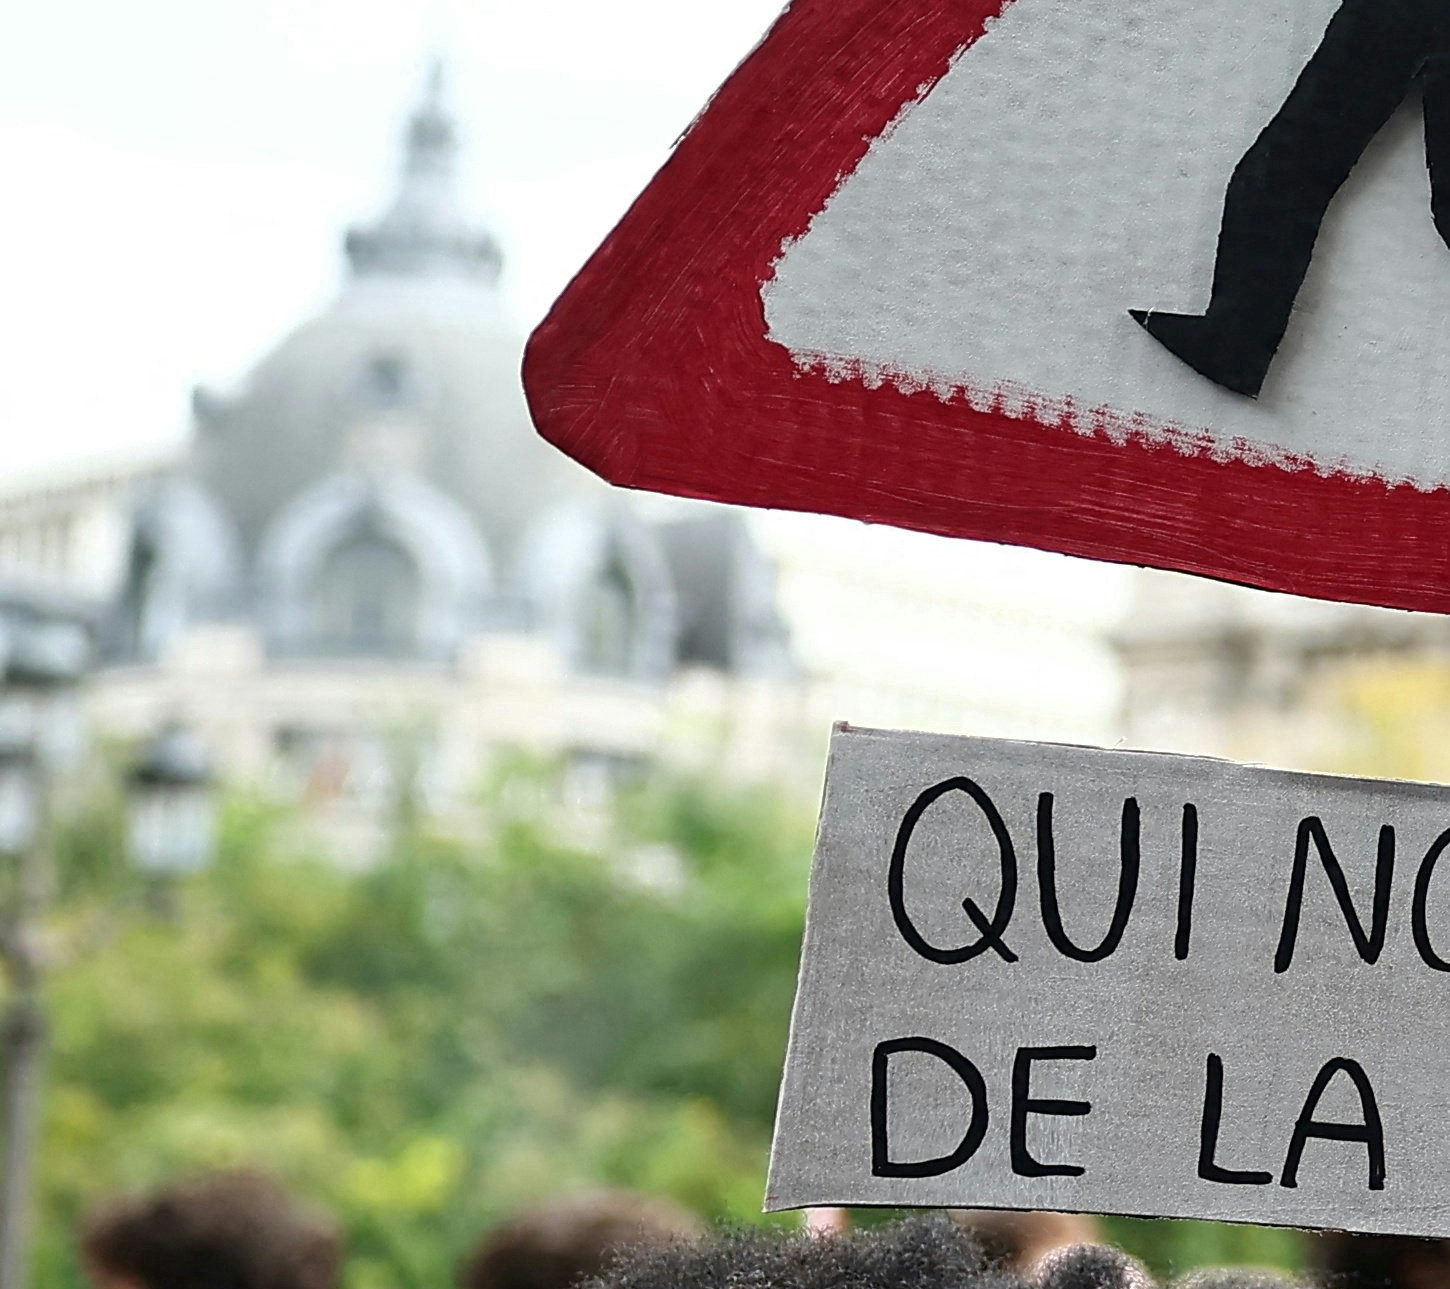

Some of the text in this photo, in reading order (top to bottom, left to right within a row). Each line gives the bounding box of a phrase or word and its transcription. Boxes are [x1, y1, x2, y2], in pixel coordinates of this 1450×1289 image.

[887, 776, 1199, 966] QUI
[869, 1035, 1098, 1180] DE
[1196, 1051, 1389, 1192] LA
